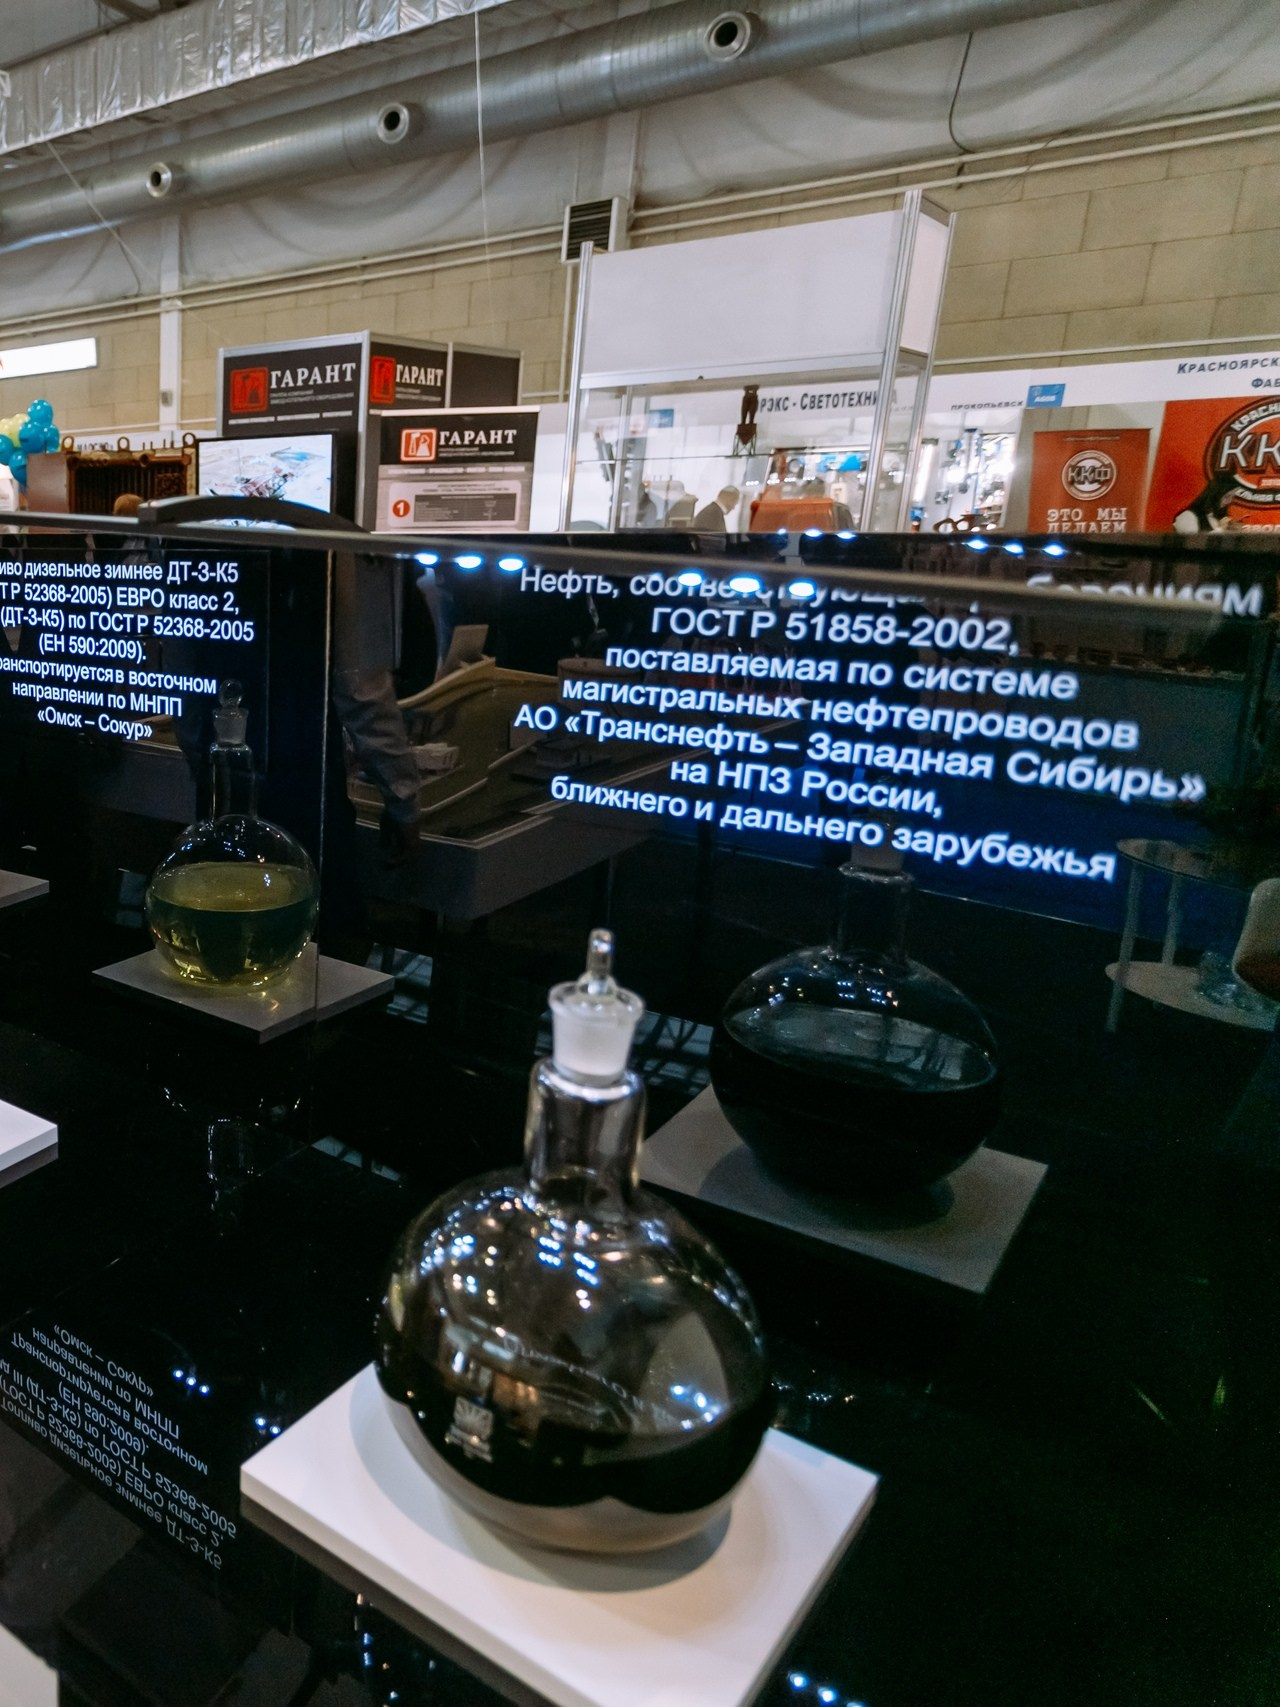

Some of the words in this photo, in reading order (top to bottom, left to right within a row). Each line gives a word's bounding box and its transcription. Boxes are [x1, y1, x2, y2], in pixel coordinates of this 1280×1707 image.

[270, 363, 356, 389] ГАРАНТ
[395, 364, 444, 387] ГАРАНТ
[439, 429, 518, 446] ГАРАНТ
[397, 501, 405, 516] 1
[1047, 507, 1083, 522] ЭТО
[1097, 507, 1128, 521] МЫ
[1047, 521, 1127, 533] ДЕЛАЕМ
[25, 561, 100, 579] дизельное
[104, 563, 162, 580] зимнее
[520, 566, 620, 599] Нефть,
[24, 585, 112, 609] 52368-2005)
[116, 587, 164, 608] ЕВРО
[169, 592, 218, 611] класс
[223, 591, 239, 615] 2,
[68, 613, 86, 630] по
[90, 612, 134, 632] ГОСТ
[153, 616, 254, 641] 52368-2005
[651, 606, 745, 637] ГОСТ
[751, 609, 777, 638] Р
[785, 612, 1019, 657] 51858-2002,
[39, 633, 65, 654] (ЕН
[69, 636, 146, 663] 590:2009).
[129, 669, 216, 694] восточном
[606, 648, 839, 683] поставляемая
[847, 662, 893, 686] по
[904, 664, 1080, 700] системе
[12, 681, 103, 705] направлении
[107, 692, 126, 709] по
[130, 692, 182, 717] МНПП
[37, 706, 81, 728] «Омск
[98, 713, 152, 740] Сокур»
[562, 680, 802, 720] магистральных
[811, 697, 1140, 750] нефтепроводов
[514, 704, 557, 731] АО
[565, 709, 769, 755] «Транснефть
[807, 732, 995, 780] Западная
[1006, 750, 1207, 803] Сибирь»
[671, 760, 708, 784] на
[718, 760, 793, 794] НПЗ
[802, 770, 943, 819] России,
[551, 775, 688, 817] ближнего
[694, 800, 714, 821] и
[721, 804, 884, 847] дальнего
[891, 826, 1117, 883] зарубежья
